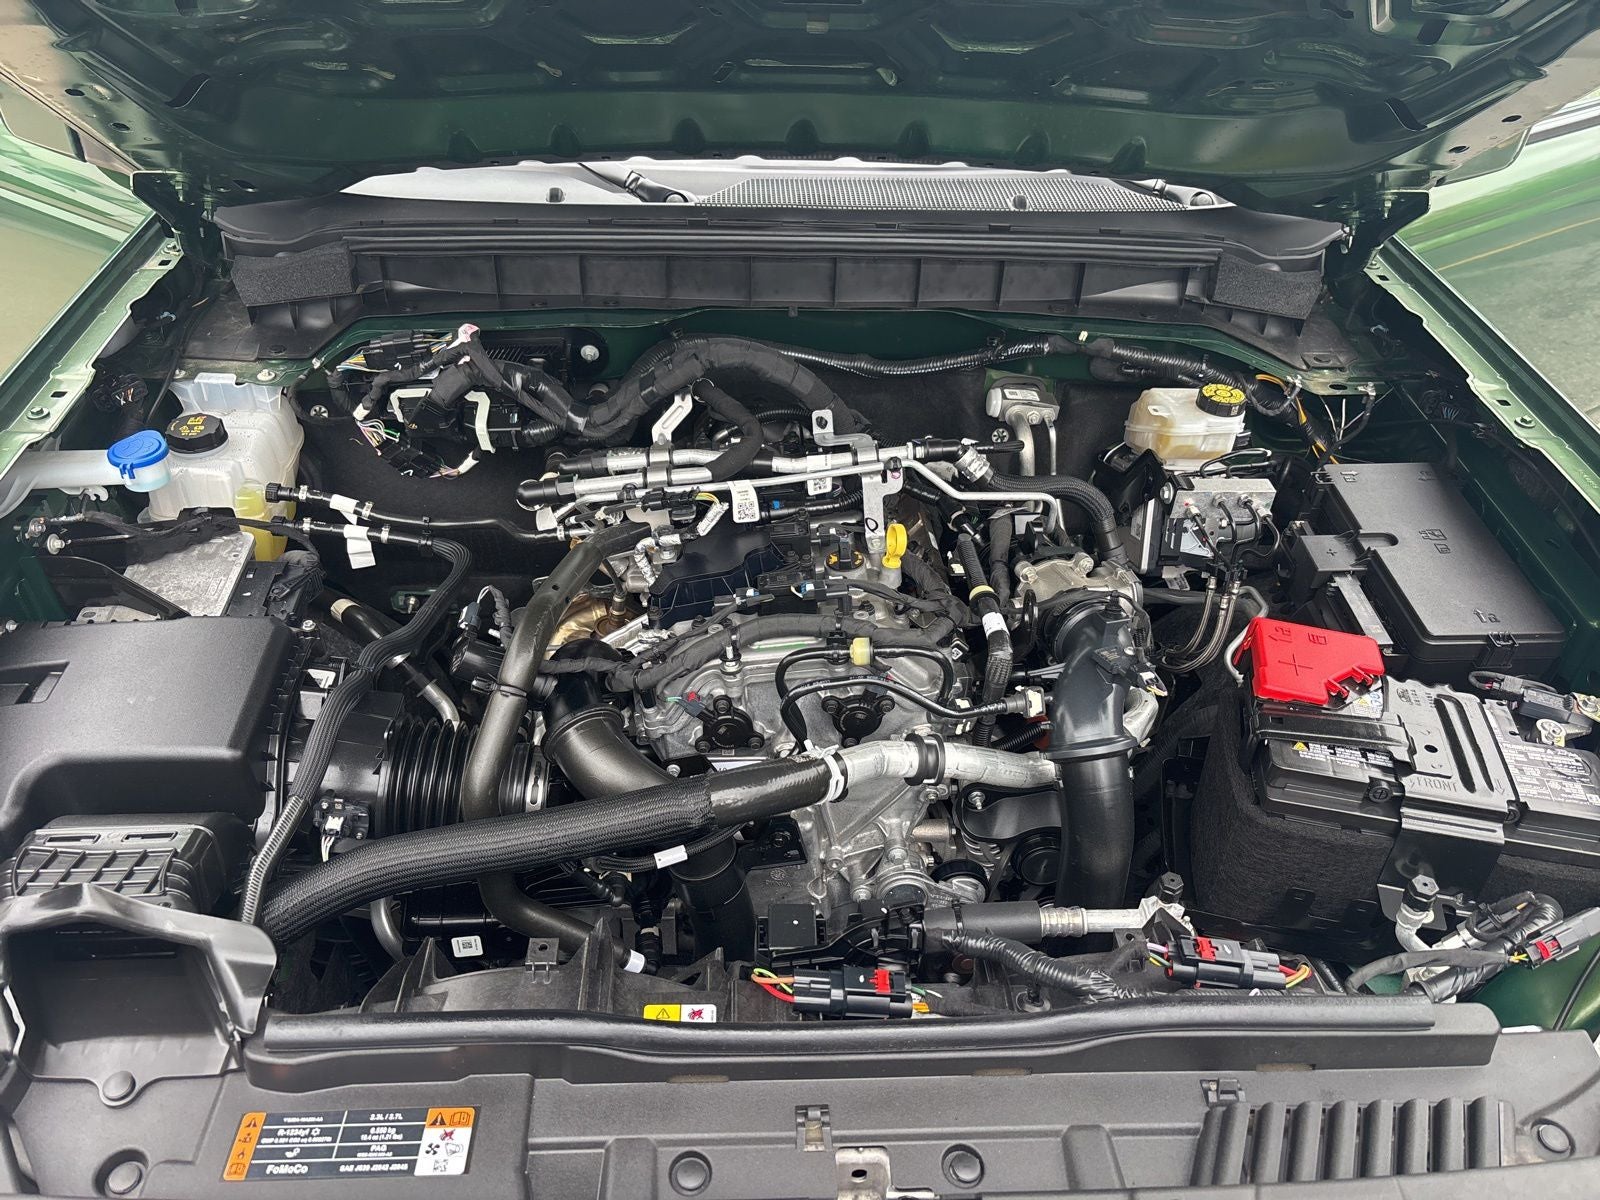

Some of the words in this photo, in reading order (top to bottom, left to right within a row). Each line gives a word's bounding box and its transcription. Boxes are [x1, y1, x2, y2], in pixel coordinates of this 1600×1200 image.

[1416, 776, 1458, 792] FRONT
[277, 1128, 310, 1137] R-1234yf
[266, 1164, 309, 1175] FoMoCo
